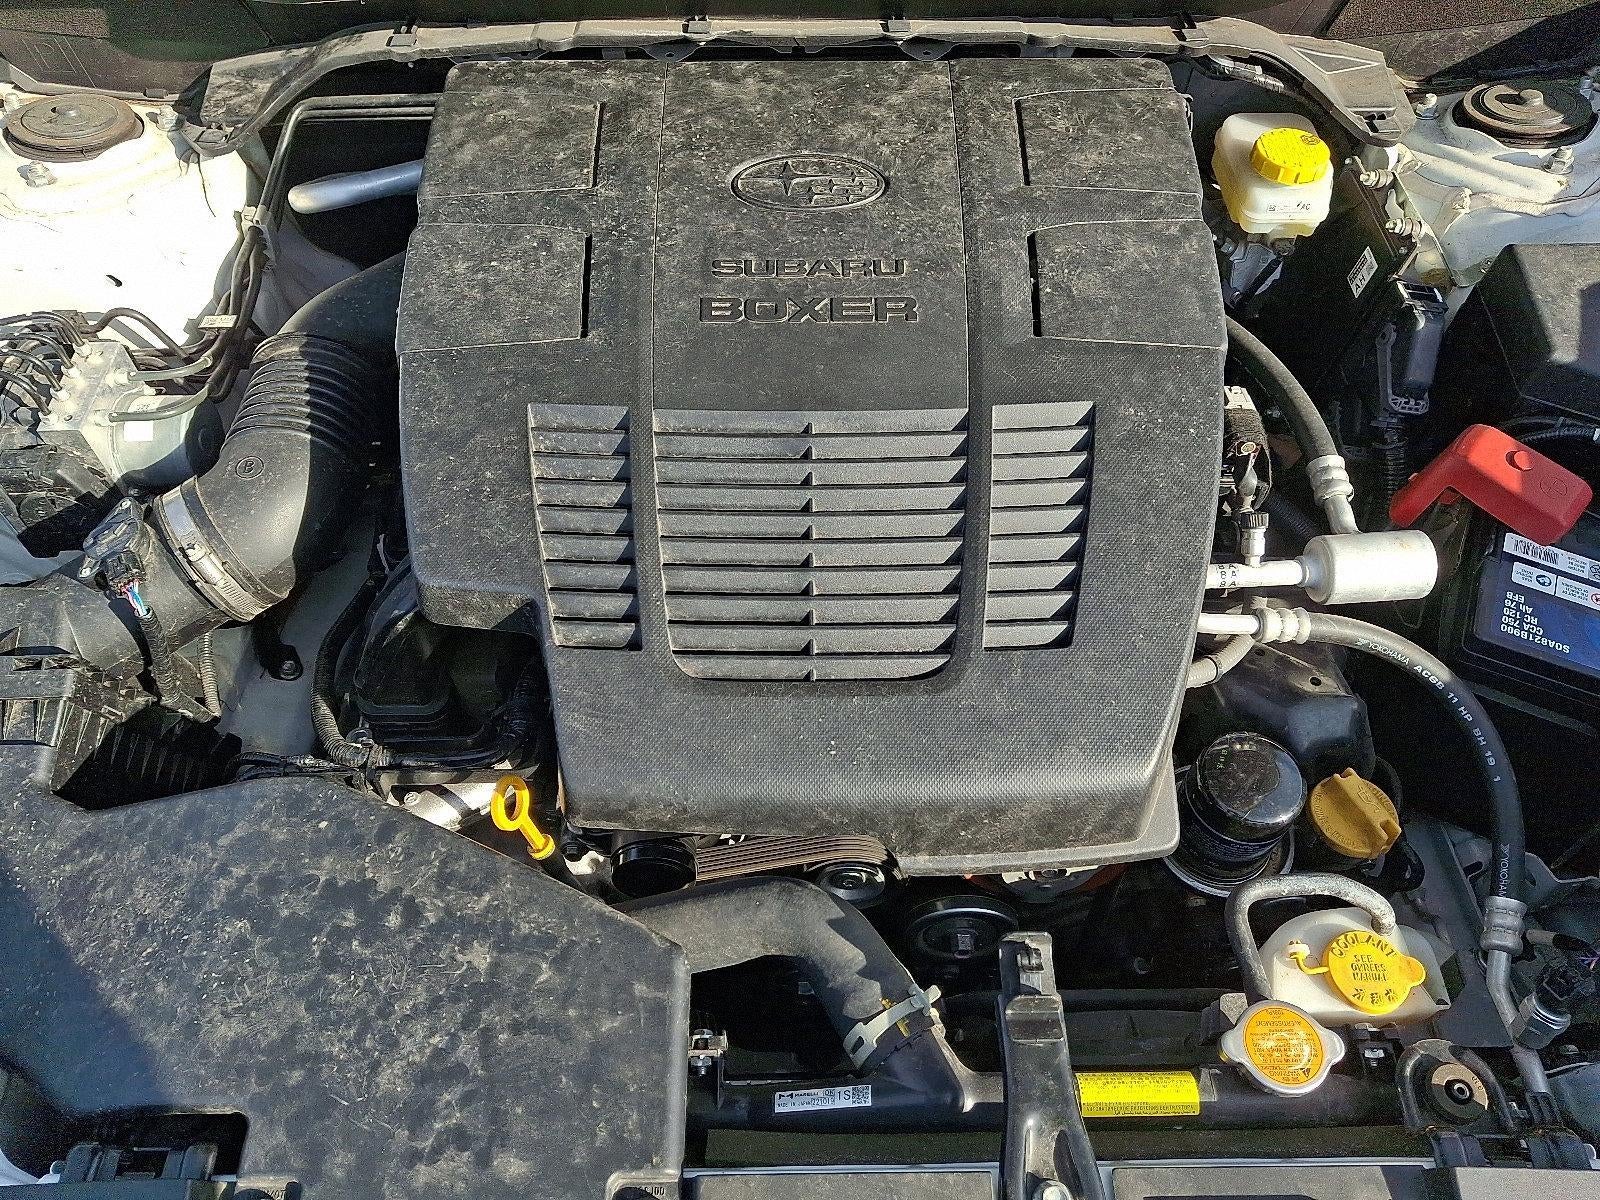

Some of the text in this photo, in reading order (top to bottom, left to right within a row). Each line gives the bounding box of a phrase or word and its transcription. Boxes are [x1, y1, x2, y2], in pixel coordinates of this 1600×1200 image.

[711, 258, 906, 278] SUBARU
[700, 296, 919, 324] BOXER
[1506, 591, 1525, 603] EFB
[1503, 607, 1538, 625] RC 120
[1520, 603, 1533, 614] Ah
[1501, 615, 1544, 636] CCA 750
[1369, 642, 1410, 665] YOKOHAMA
[1458, 706, 1473, 722] HP
[1472, 727, 1487, 746] BH
[1485, 750, 1496, 766] 19
[1498, 857, 1509, 897] YOKOHAM
[1331, 933, 1398, 958] COOLANT
[1353, 954, 1373, 963] SEE
[1352, 972, 1388, 982] MANUAL
